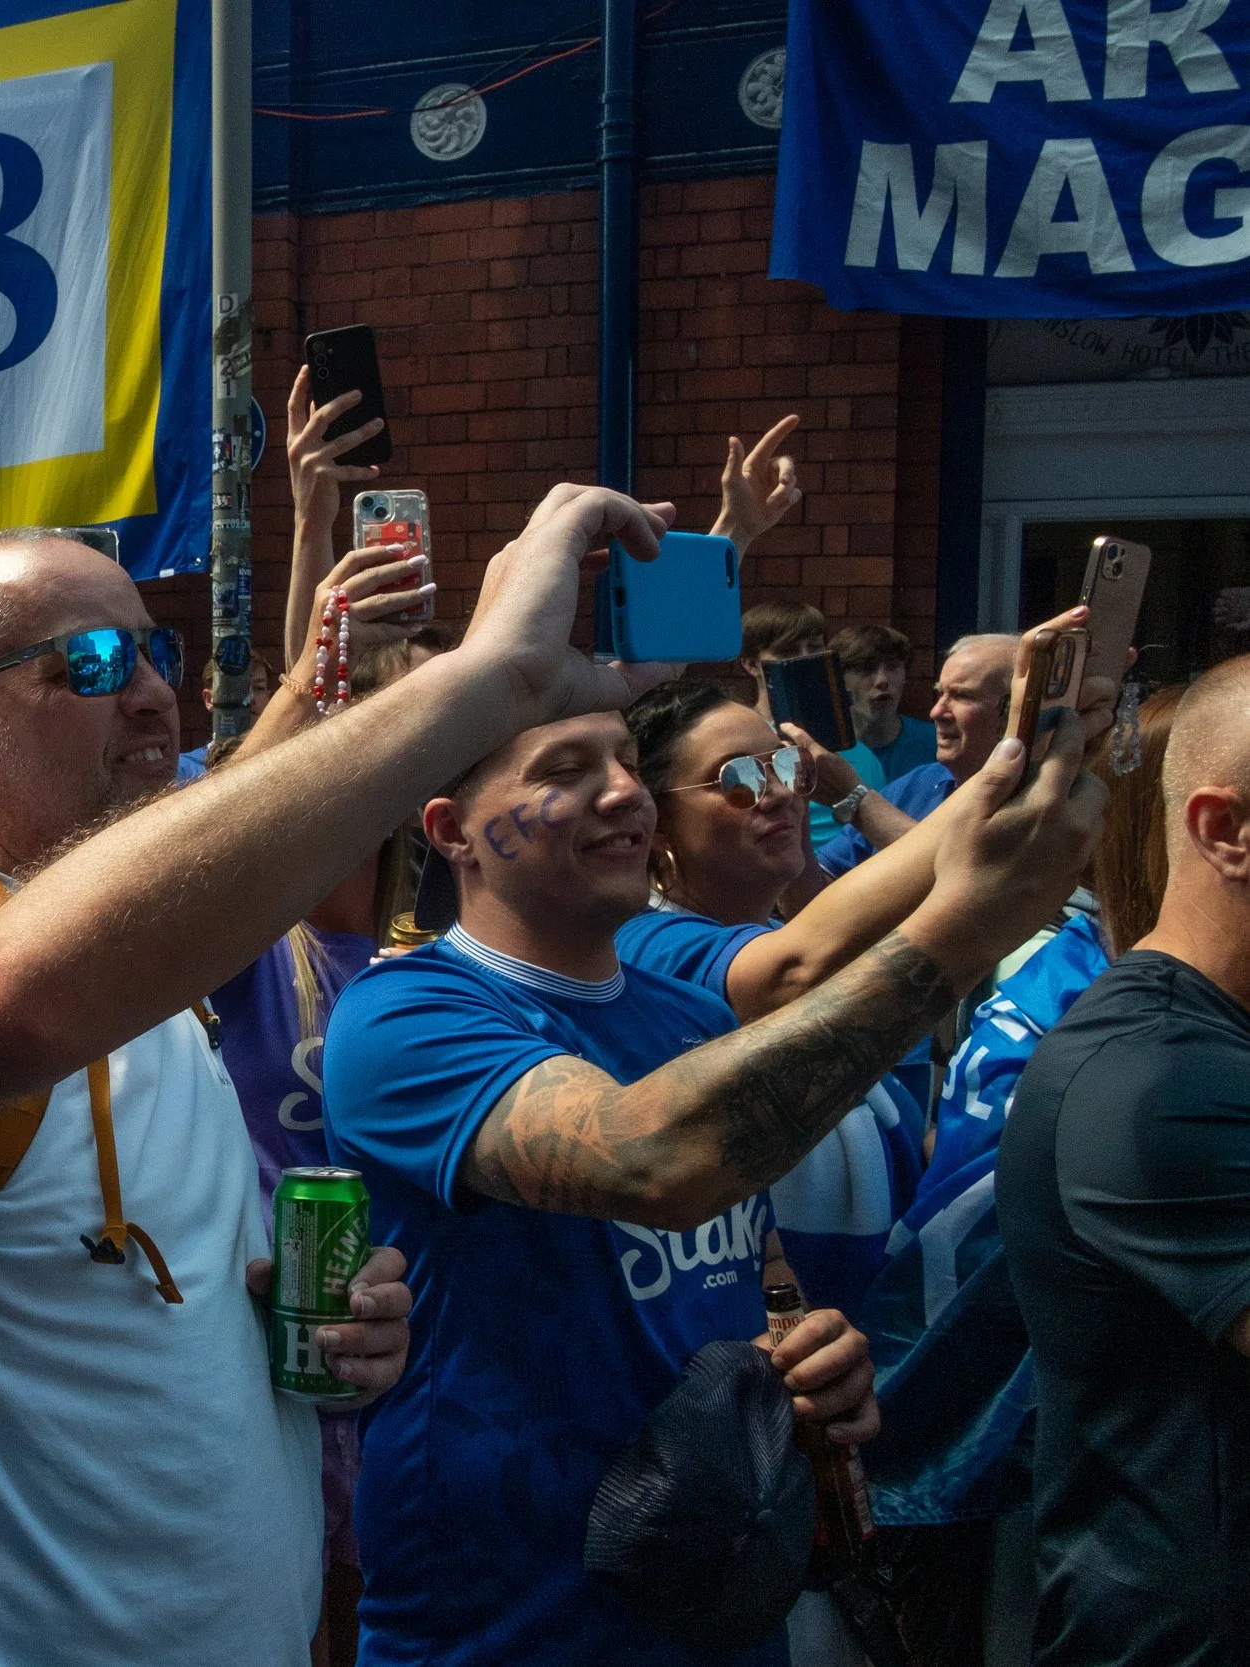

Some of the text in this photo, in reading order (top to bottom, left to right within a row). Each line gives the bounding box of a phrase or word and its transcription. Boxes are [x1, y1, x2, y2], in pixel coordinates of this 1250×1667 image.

[950, 0, 1241, 103] AR
[844, 124, 1250, 278] MAG
[484, 784, 568, 860] EFC
[702, 1269, 739, 1290] .com
